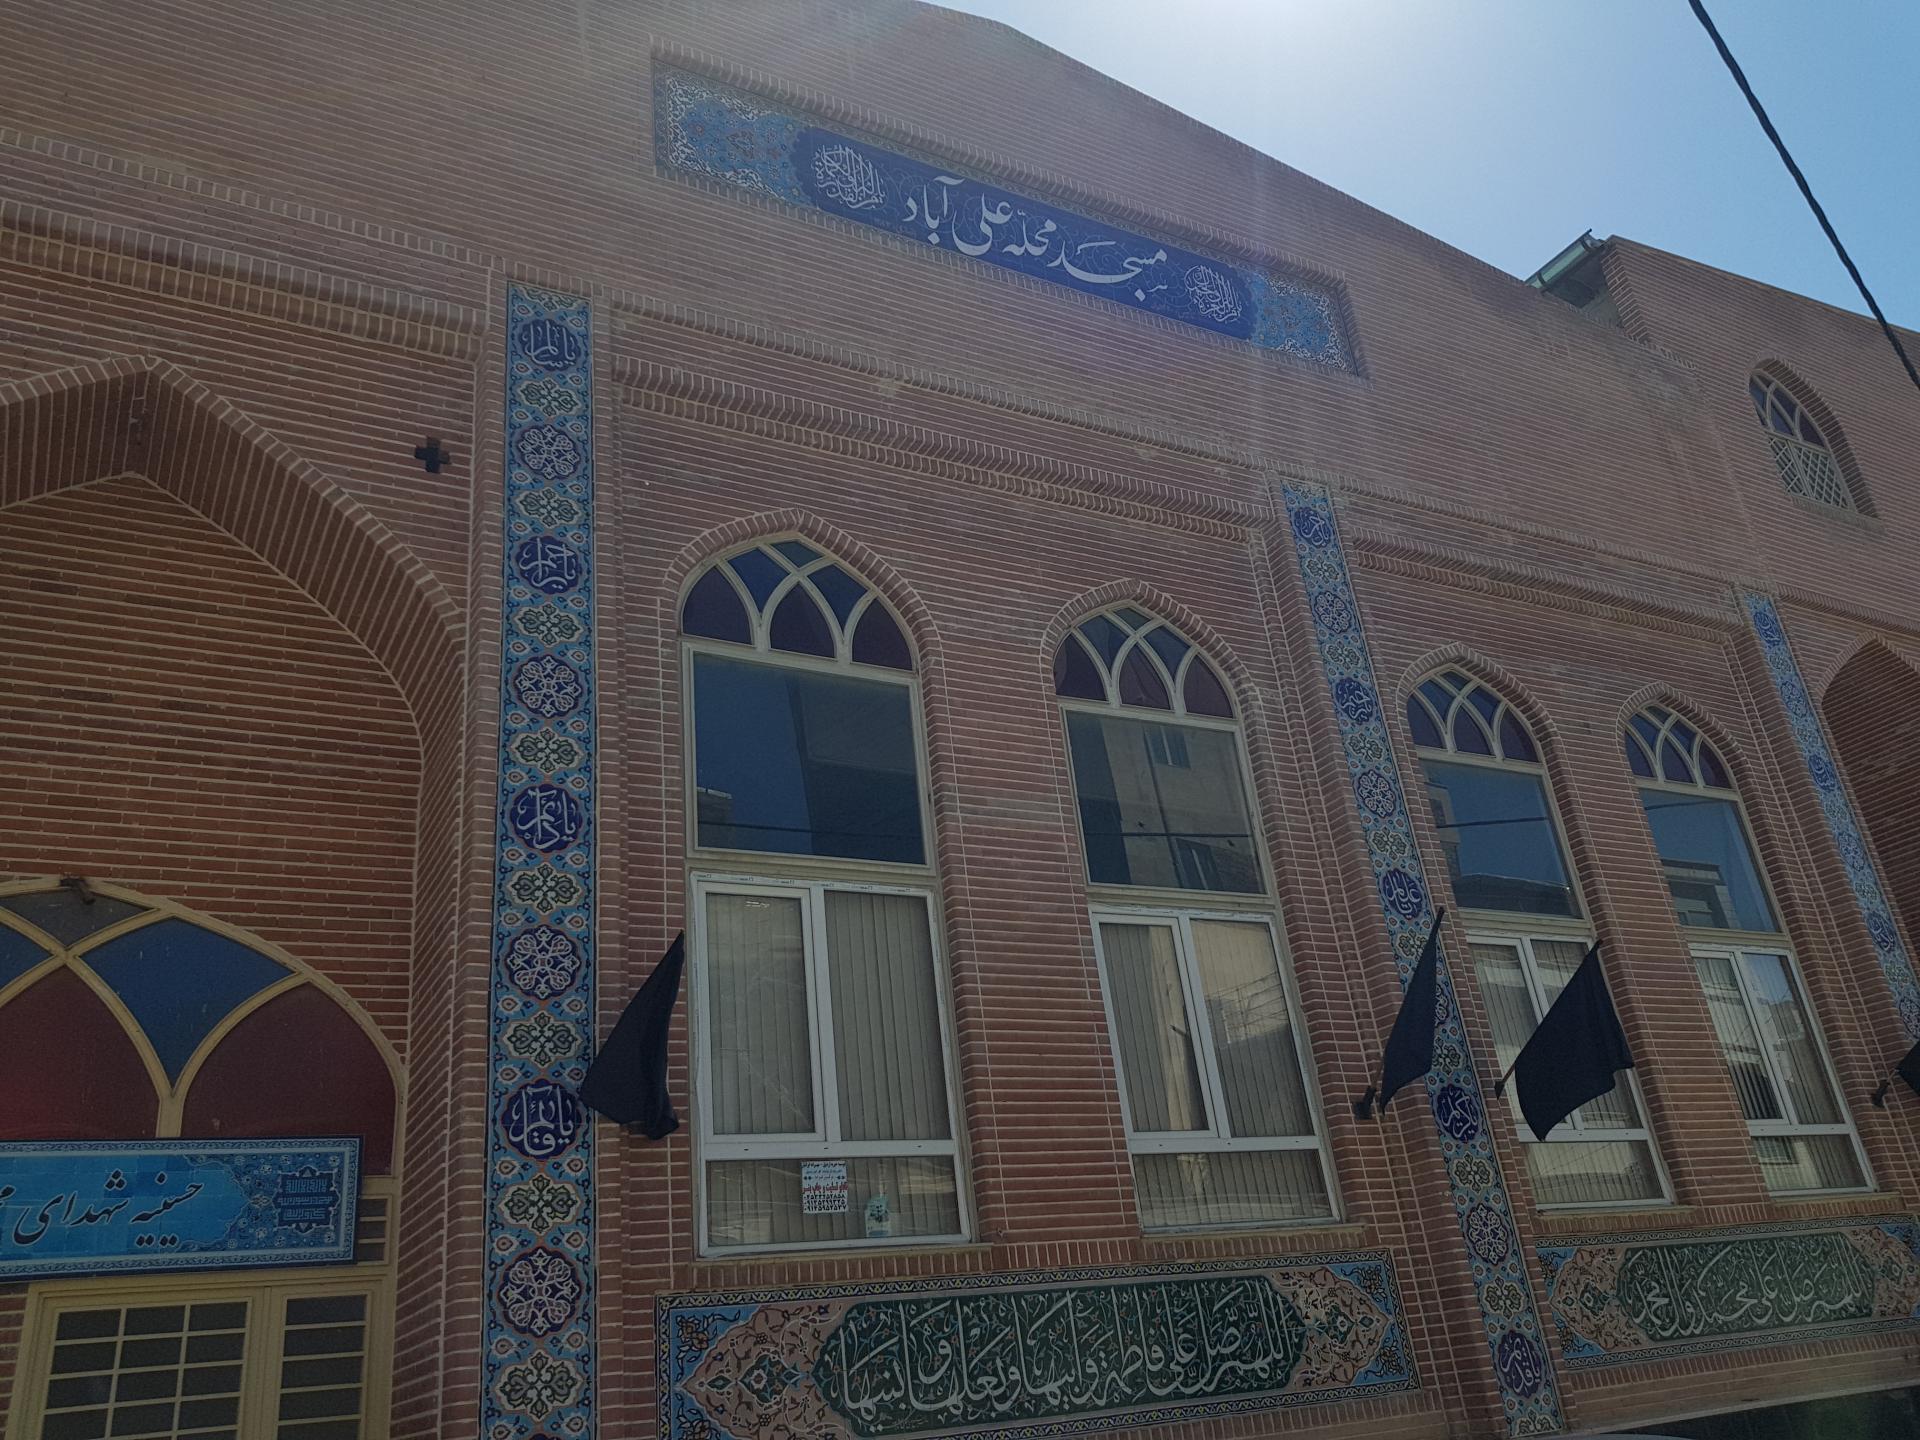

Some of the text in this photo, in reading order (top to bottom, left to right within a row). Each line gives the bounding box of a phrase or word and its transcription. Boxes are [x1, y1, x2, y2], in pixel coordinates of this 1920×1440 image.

[902, 175, 966, 246] آباد
[952, 192, 1013, 256] علی
[1047, 240, 1168, 301] مسجد
[12, 1168, 205, 1247] حسینیه شهدای
